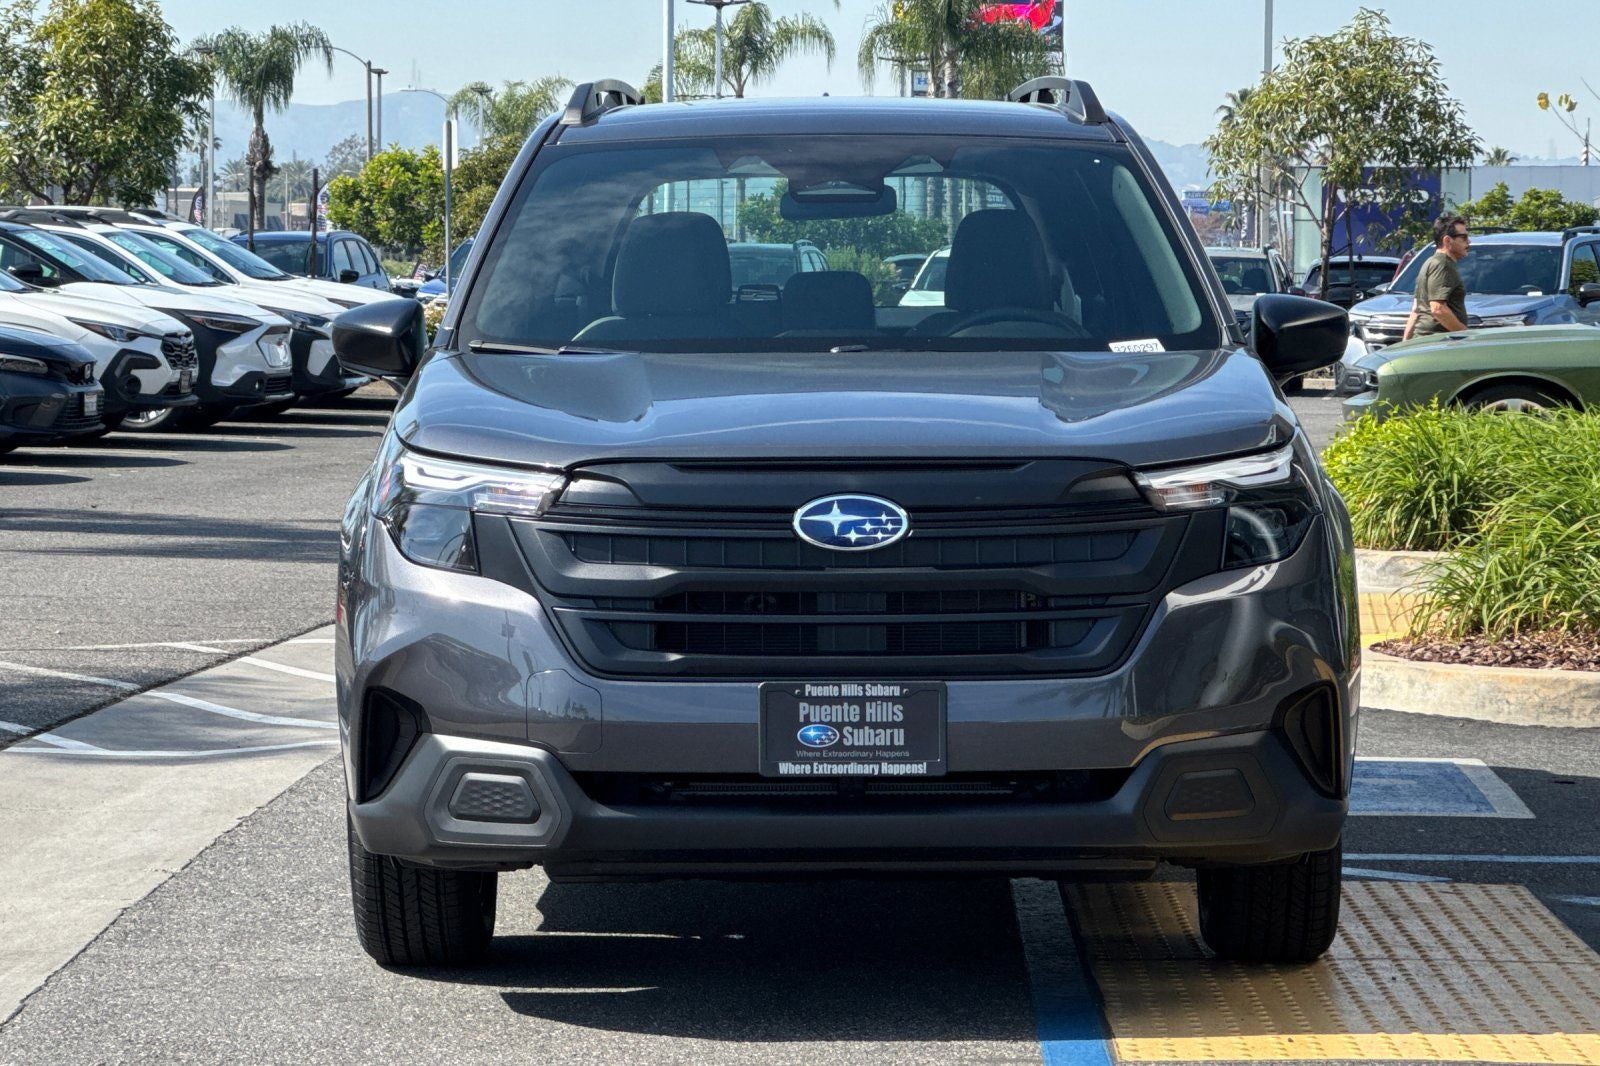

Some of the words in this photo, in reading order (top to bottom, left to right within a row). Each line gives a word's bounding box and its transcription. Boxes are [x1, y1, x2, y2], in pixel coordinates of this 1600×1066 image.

[805, 684, 839, 697] Puente
[841, 684, 864, 697] Hills
[865, 684, 900, 697] Subaru
[799, 702, 860, 723] Puente
[865, 701, 904, 723] Hills
[842, 726, 905, 746] Subaru
[822, 750, 873, 758] Extraordinary
[875, 750, 910, 758] Happens
[778, 762, 811, 775] Where
[813, 762, 880, 776] Extraordinary
[881, 762, 927, 776] Happens!
